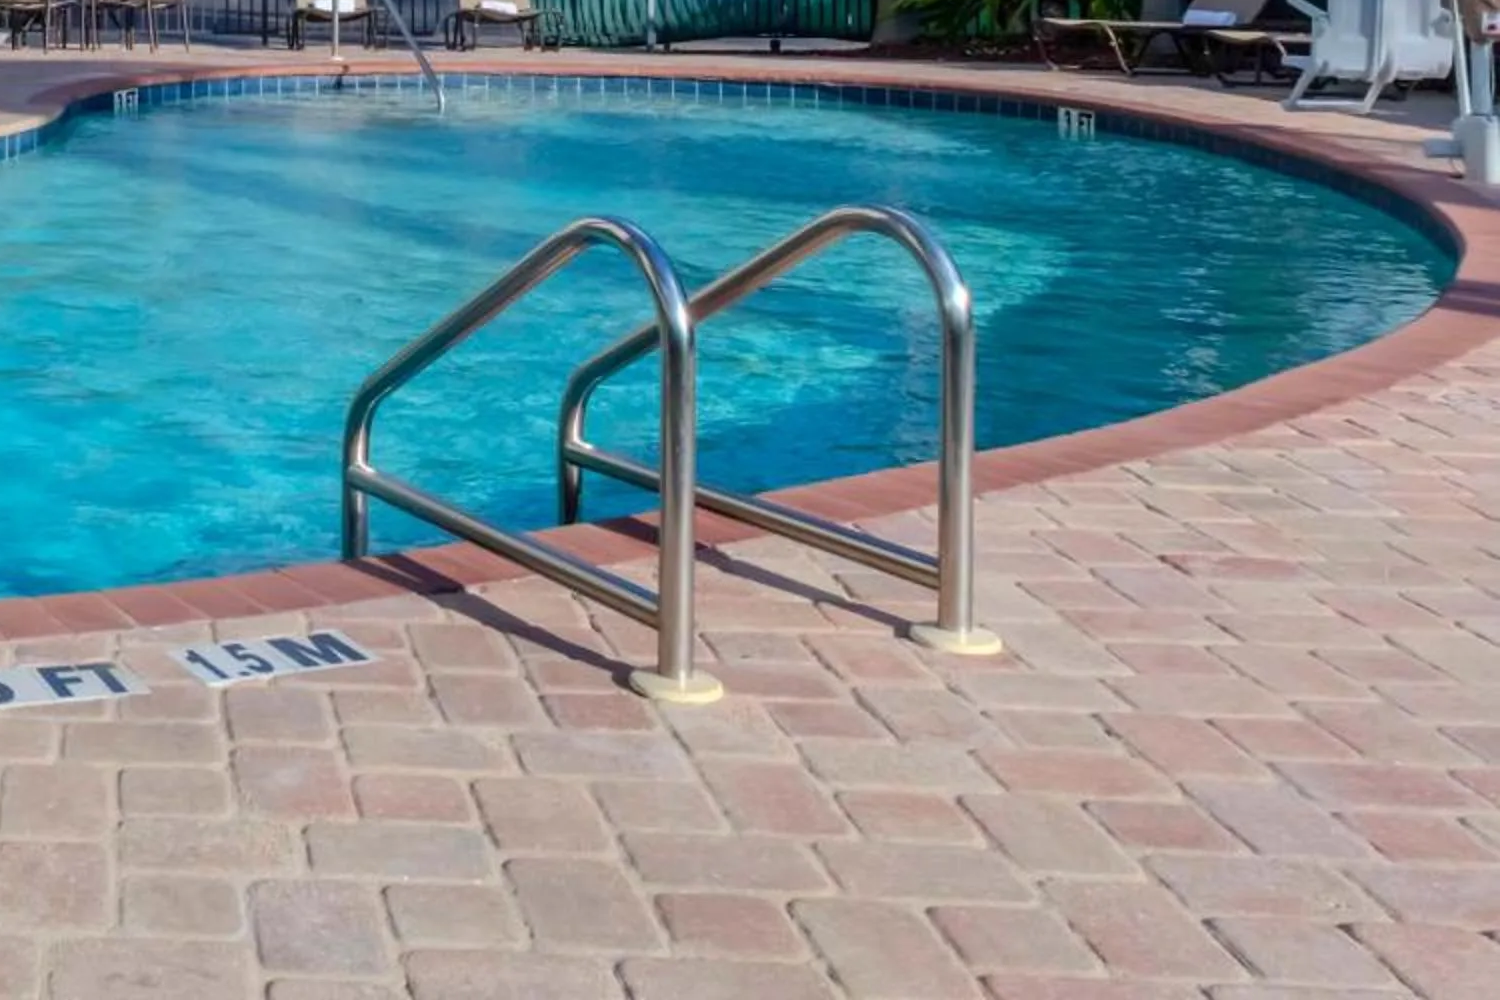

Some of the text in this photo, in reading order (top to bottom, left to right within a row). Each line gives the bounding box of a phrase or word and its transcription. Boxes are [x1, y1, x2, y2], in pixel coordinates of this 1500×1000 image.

[36, 662, 128, 698] FT
[185, 643, 275, 677] 1.5
[266, 632, 368, 667] M
